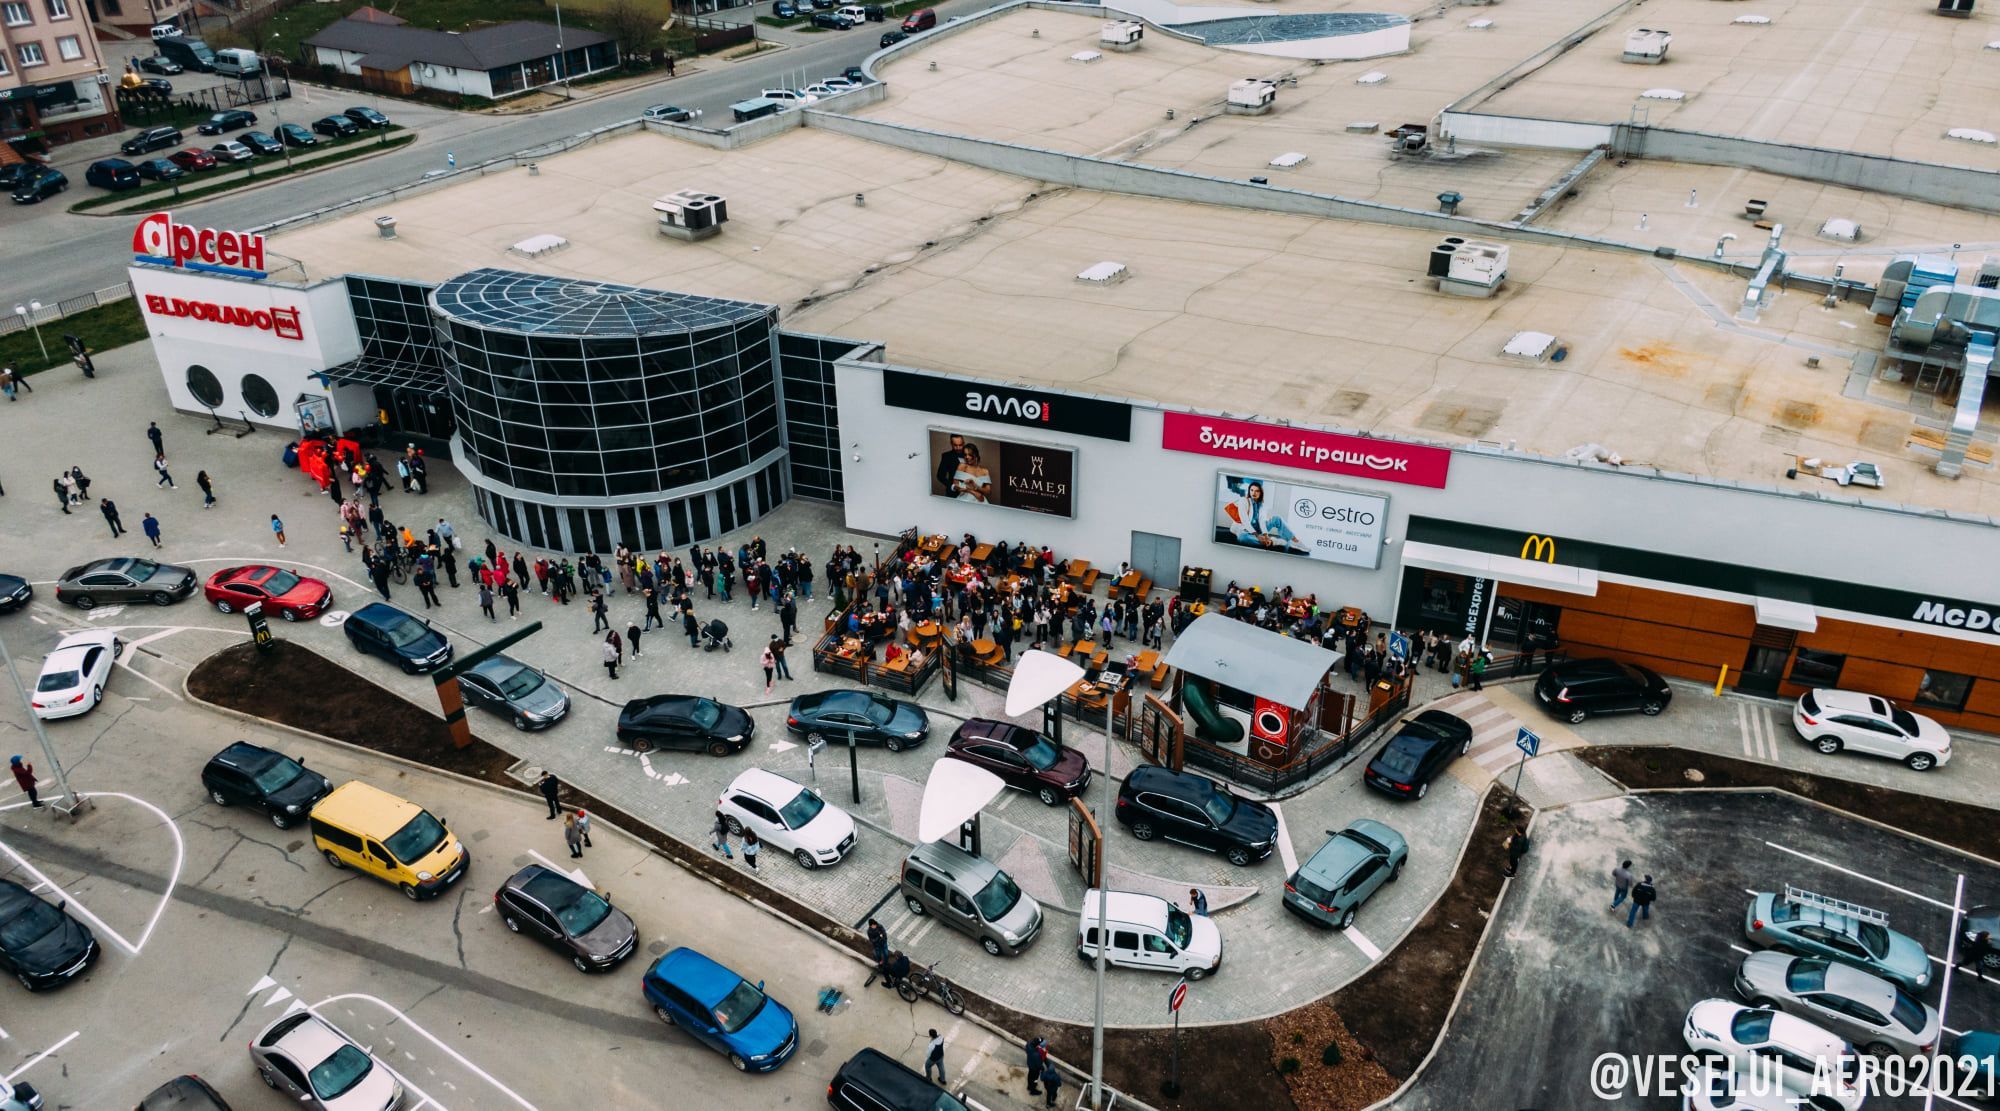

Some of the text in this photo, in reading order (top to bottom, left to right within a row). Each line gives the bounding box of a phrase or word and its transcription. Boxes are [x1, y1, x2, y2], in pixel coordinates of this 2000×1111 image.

[133, 212, 265, 270] арсен
[145, 294, 272, 330] ELDORADO
[966, 392, 1041, 420] алло
[1199, 426, 1293, 455] будинок
[1009, 475, 1066, 494] КАМЕЯ
[1322, 506, 1375, 525] estro
[1316, 539, 1358, 552] estro.ua
